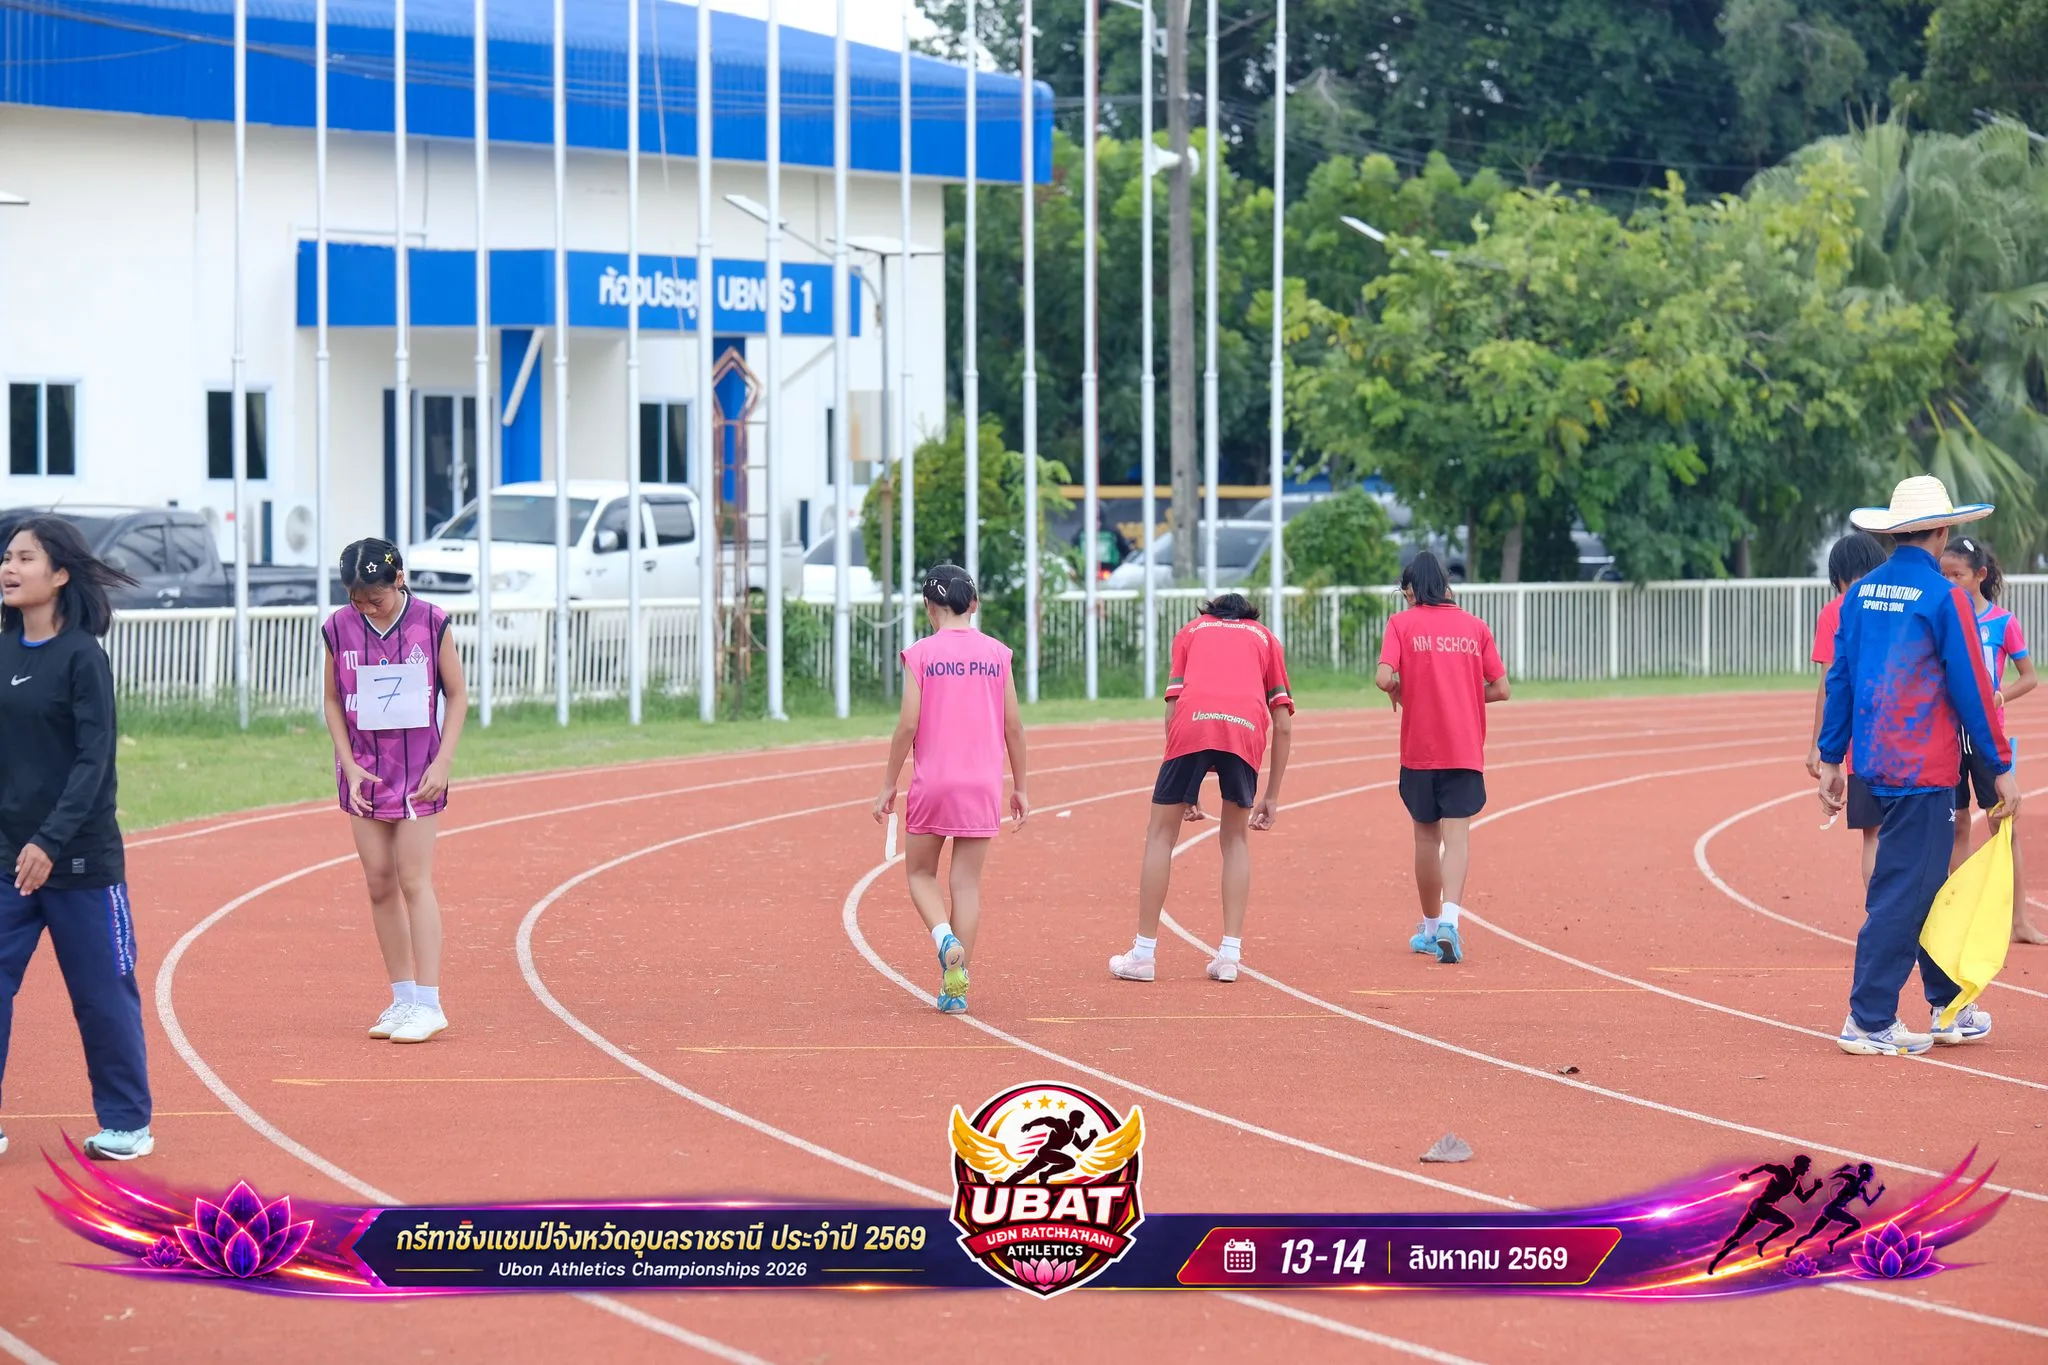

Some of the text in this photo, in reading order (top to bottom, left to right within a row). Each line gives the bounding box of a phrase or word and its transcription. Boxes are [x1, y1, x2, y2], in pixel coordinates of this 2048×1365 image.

[599, 265, 813, 320] ห้องประชุ UBNS 1
[1862, 599, 1889, 612] SPORTS
[1412, 635, 1480, 657] NM SCHOOL
[926, 661, 1001, 678] NONG PHAI
[373, 676, 403, 713] 7
